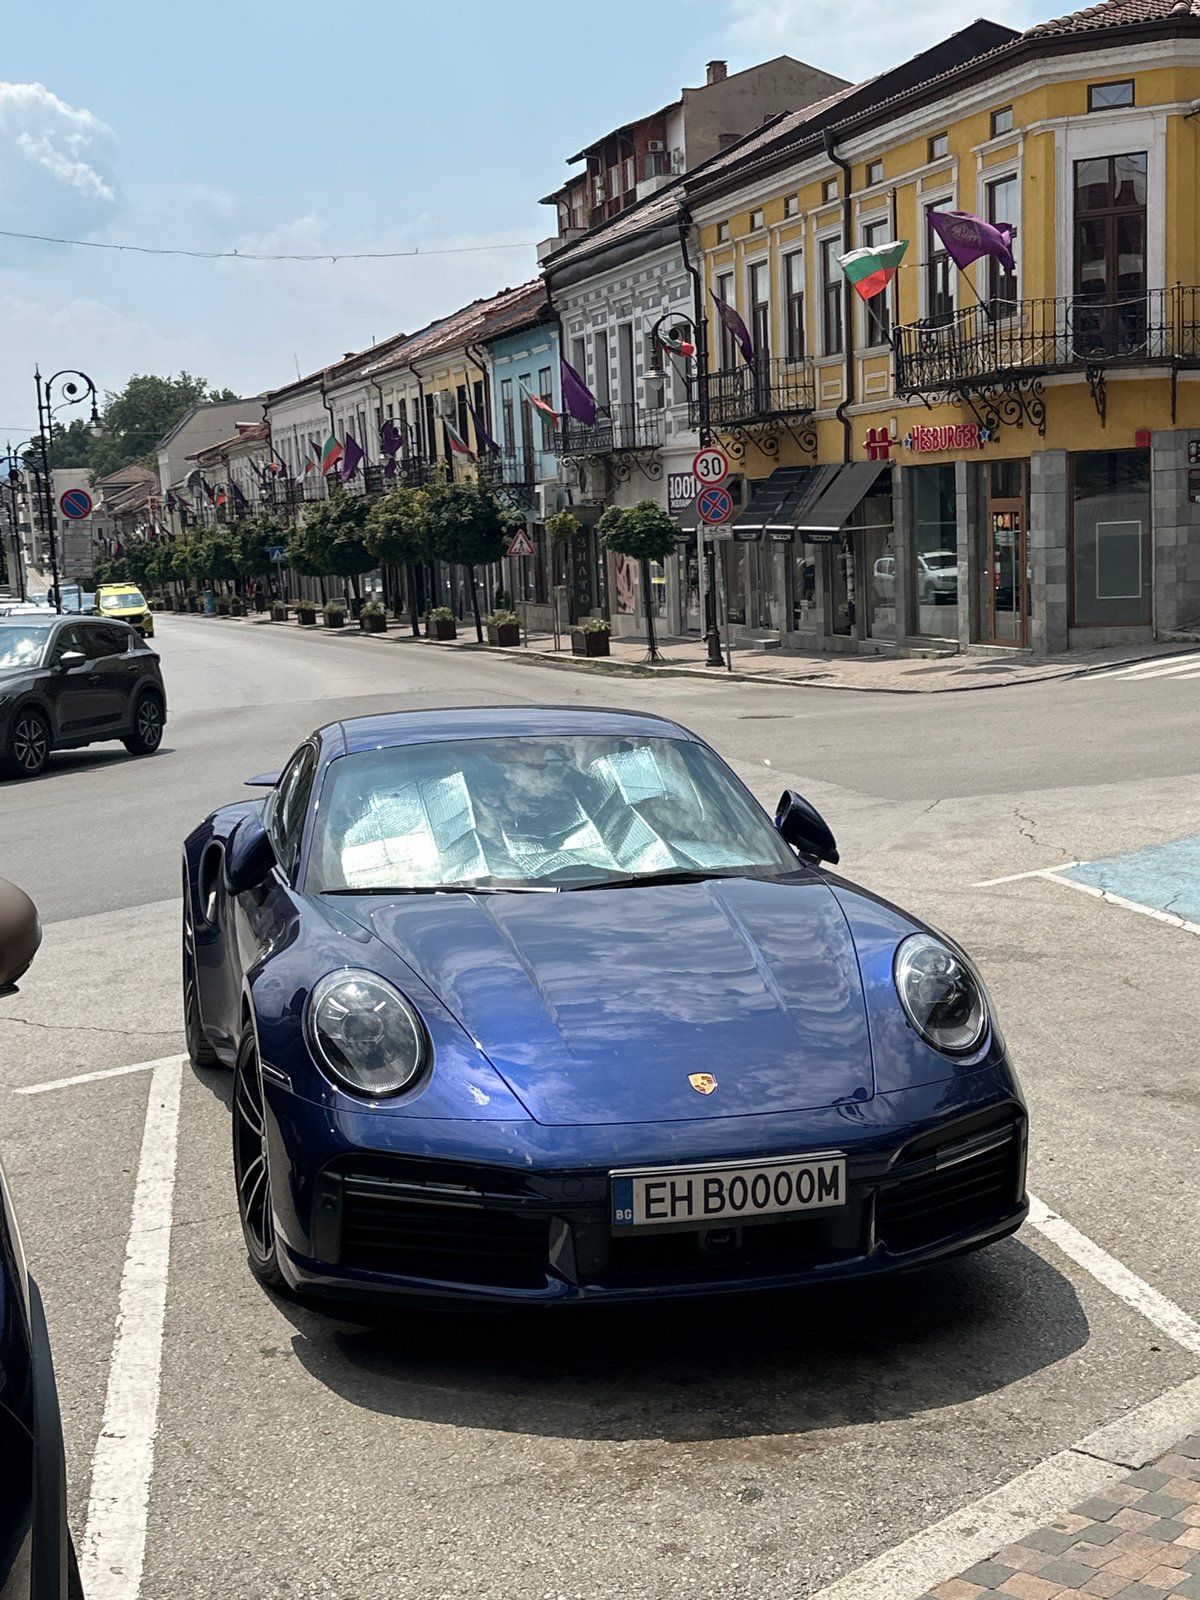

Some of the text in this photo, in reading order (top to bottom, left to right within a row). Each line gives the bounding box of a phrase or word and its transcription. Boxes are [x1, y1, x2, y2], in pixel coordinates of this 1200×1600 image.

[911, 423, 979, 452] HESBURGER
[699, 457, 722, 477] 30
[669, 475, 696, 499] 1001
[576, 538, 590, 603] ЗЛАТО
[644, 1180, 693, 1219] EH
[615, 1209, 633, 1220] BG
